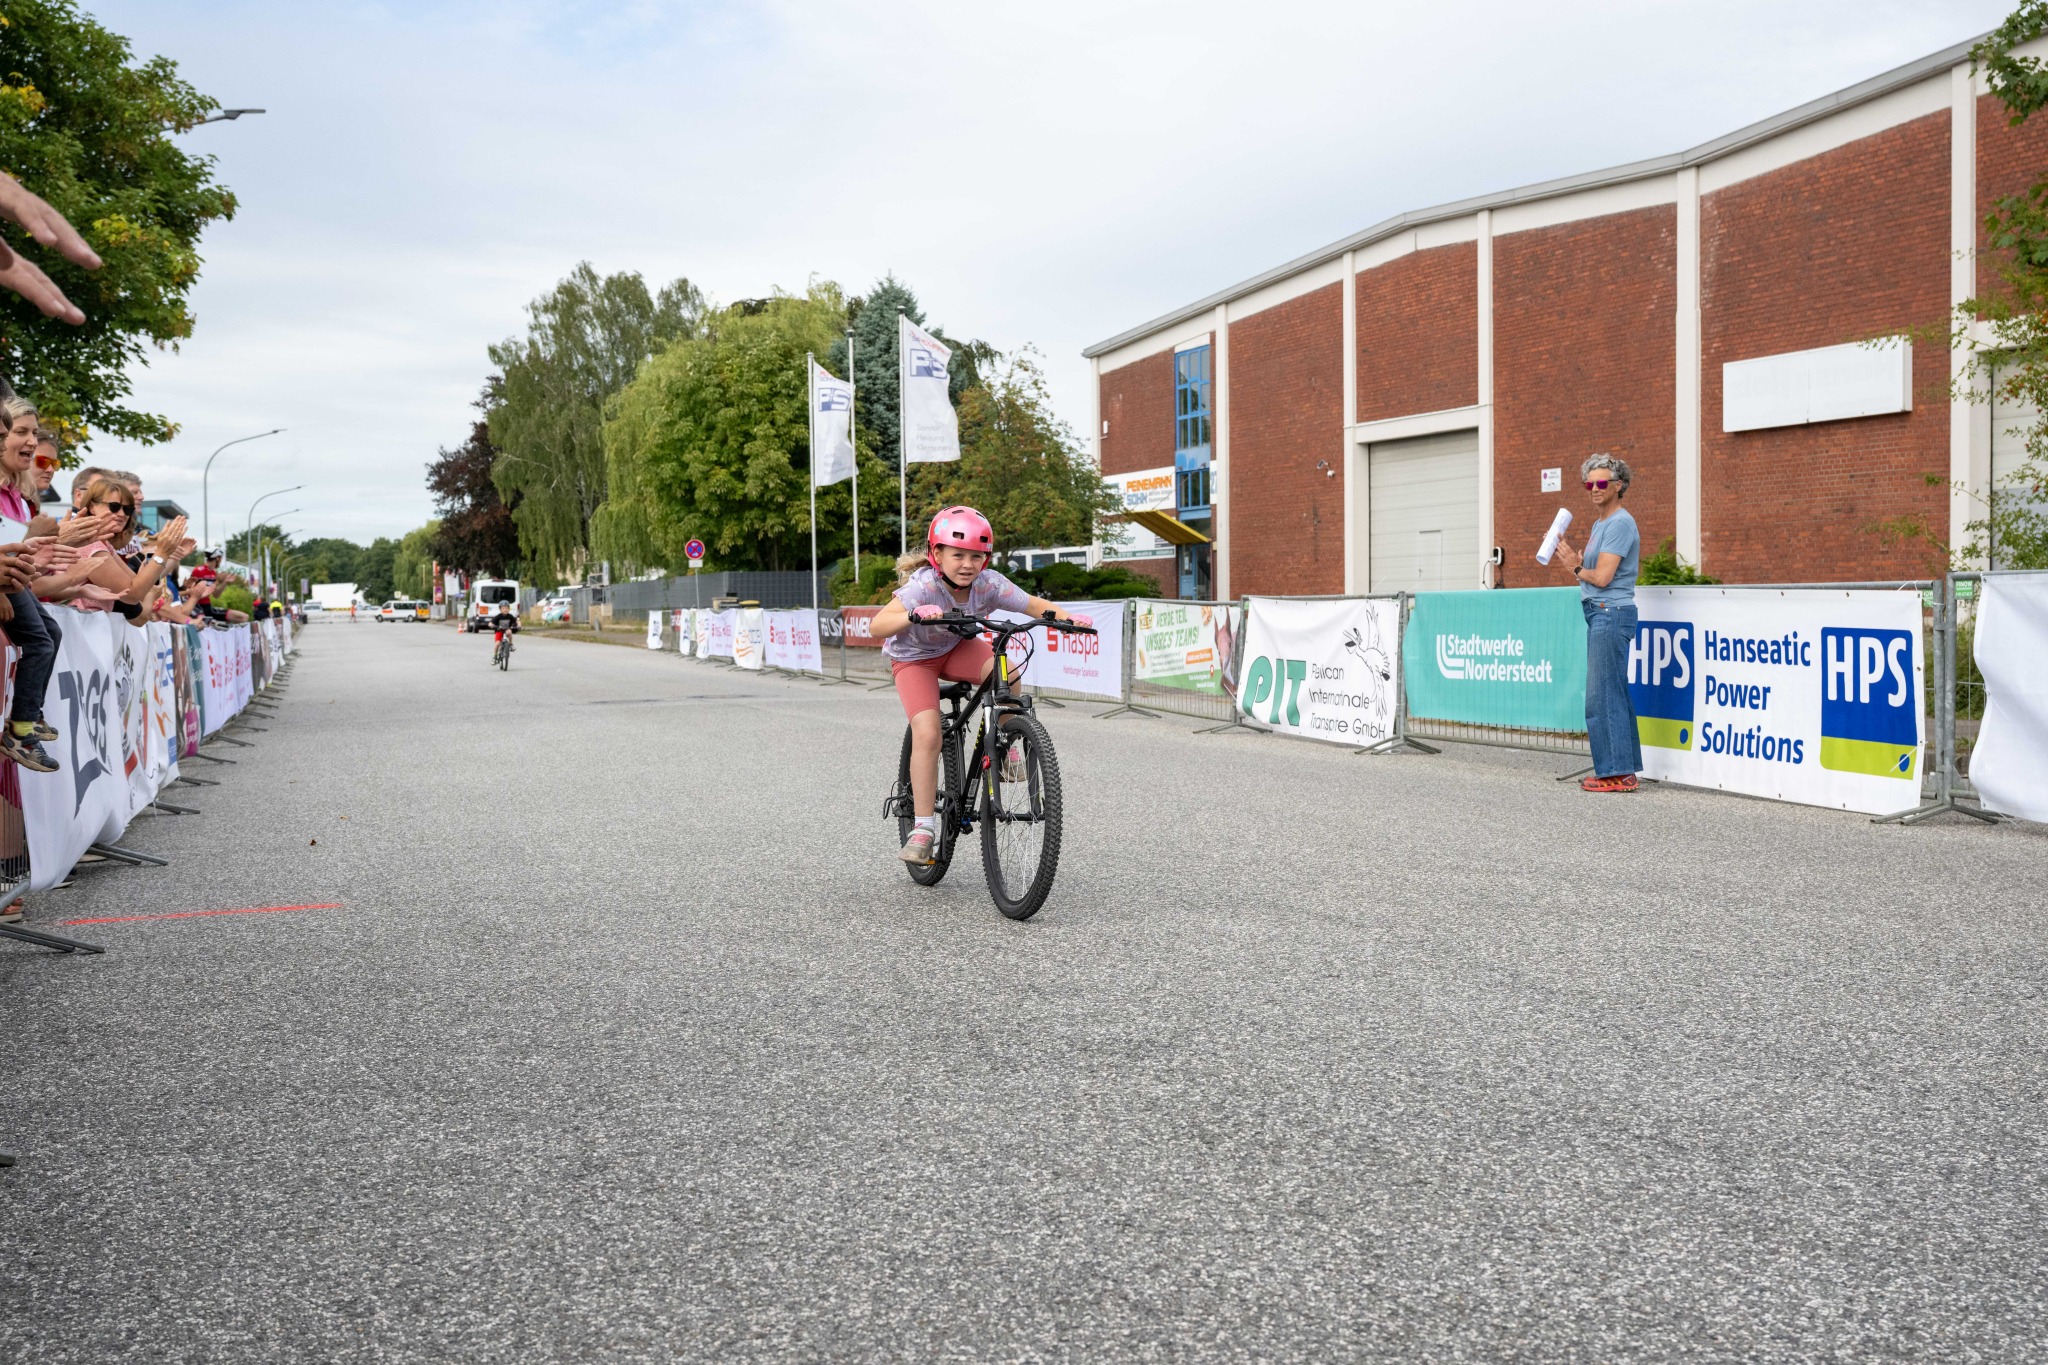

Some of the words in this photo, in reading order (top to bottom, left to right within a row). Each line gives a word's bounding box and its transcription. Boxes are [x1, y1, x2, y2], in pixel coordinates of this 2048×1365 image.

[1447, 634, 1524, 657] Stadtwerke
[1627, 628, 1690, 689] HPS
[1704, 630, 1811, 667] Hanseatic
[1311, 663, 1344, 681] Pelican
[1465, 658, 1552, 683] Norderstedt
[1826, 634, 1907, 708] HPS
[1242, 656, 1306, 727] PIT
[1309, 688, 1370, 710] Internatinale
[1705, 675, 1771, 711] Power
[1352, 718, 1387, 741] GmbH
[1701, 722, 1804, 764] Solutions
